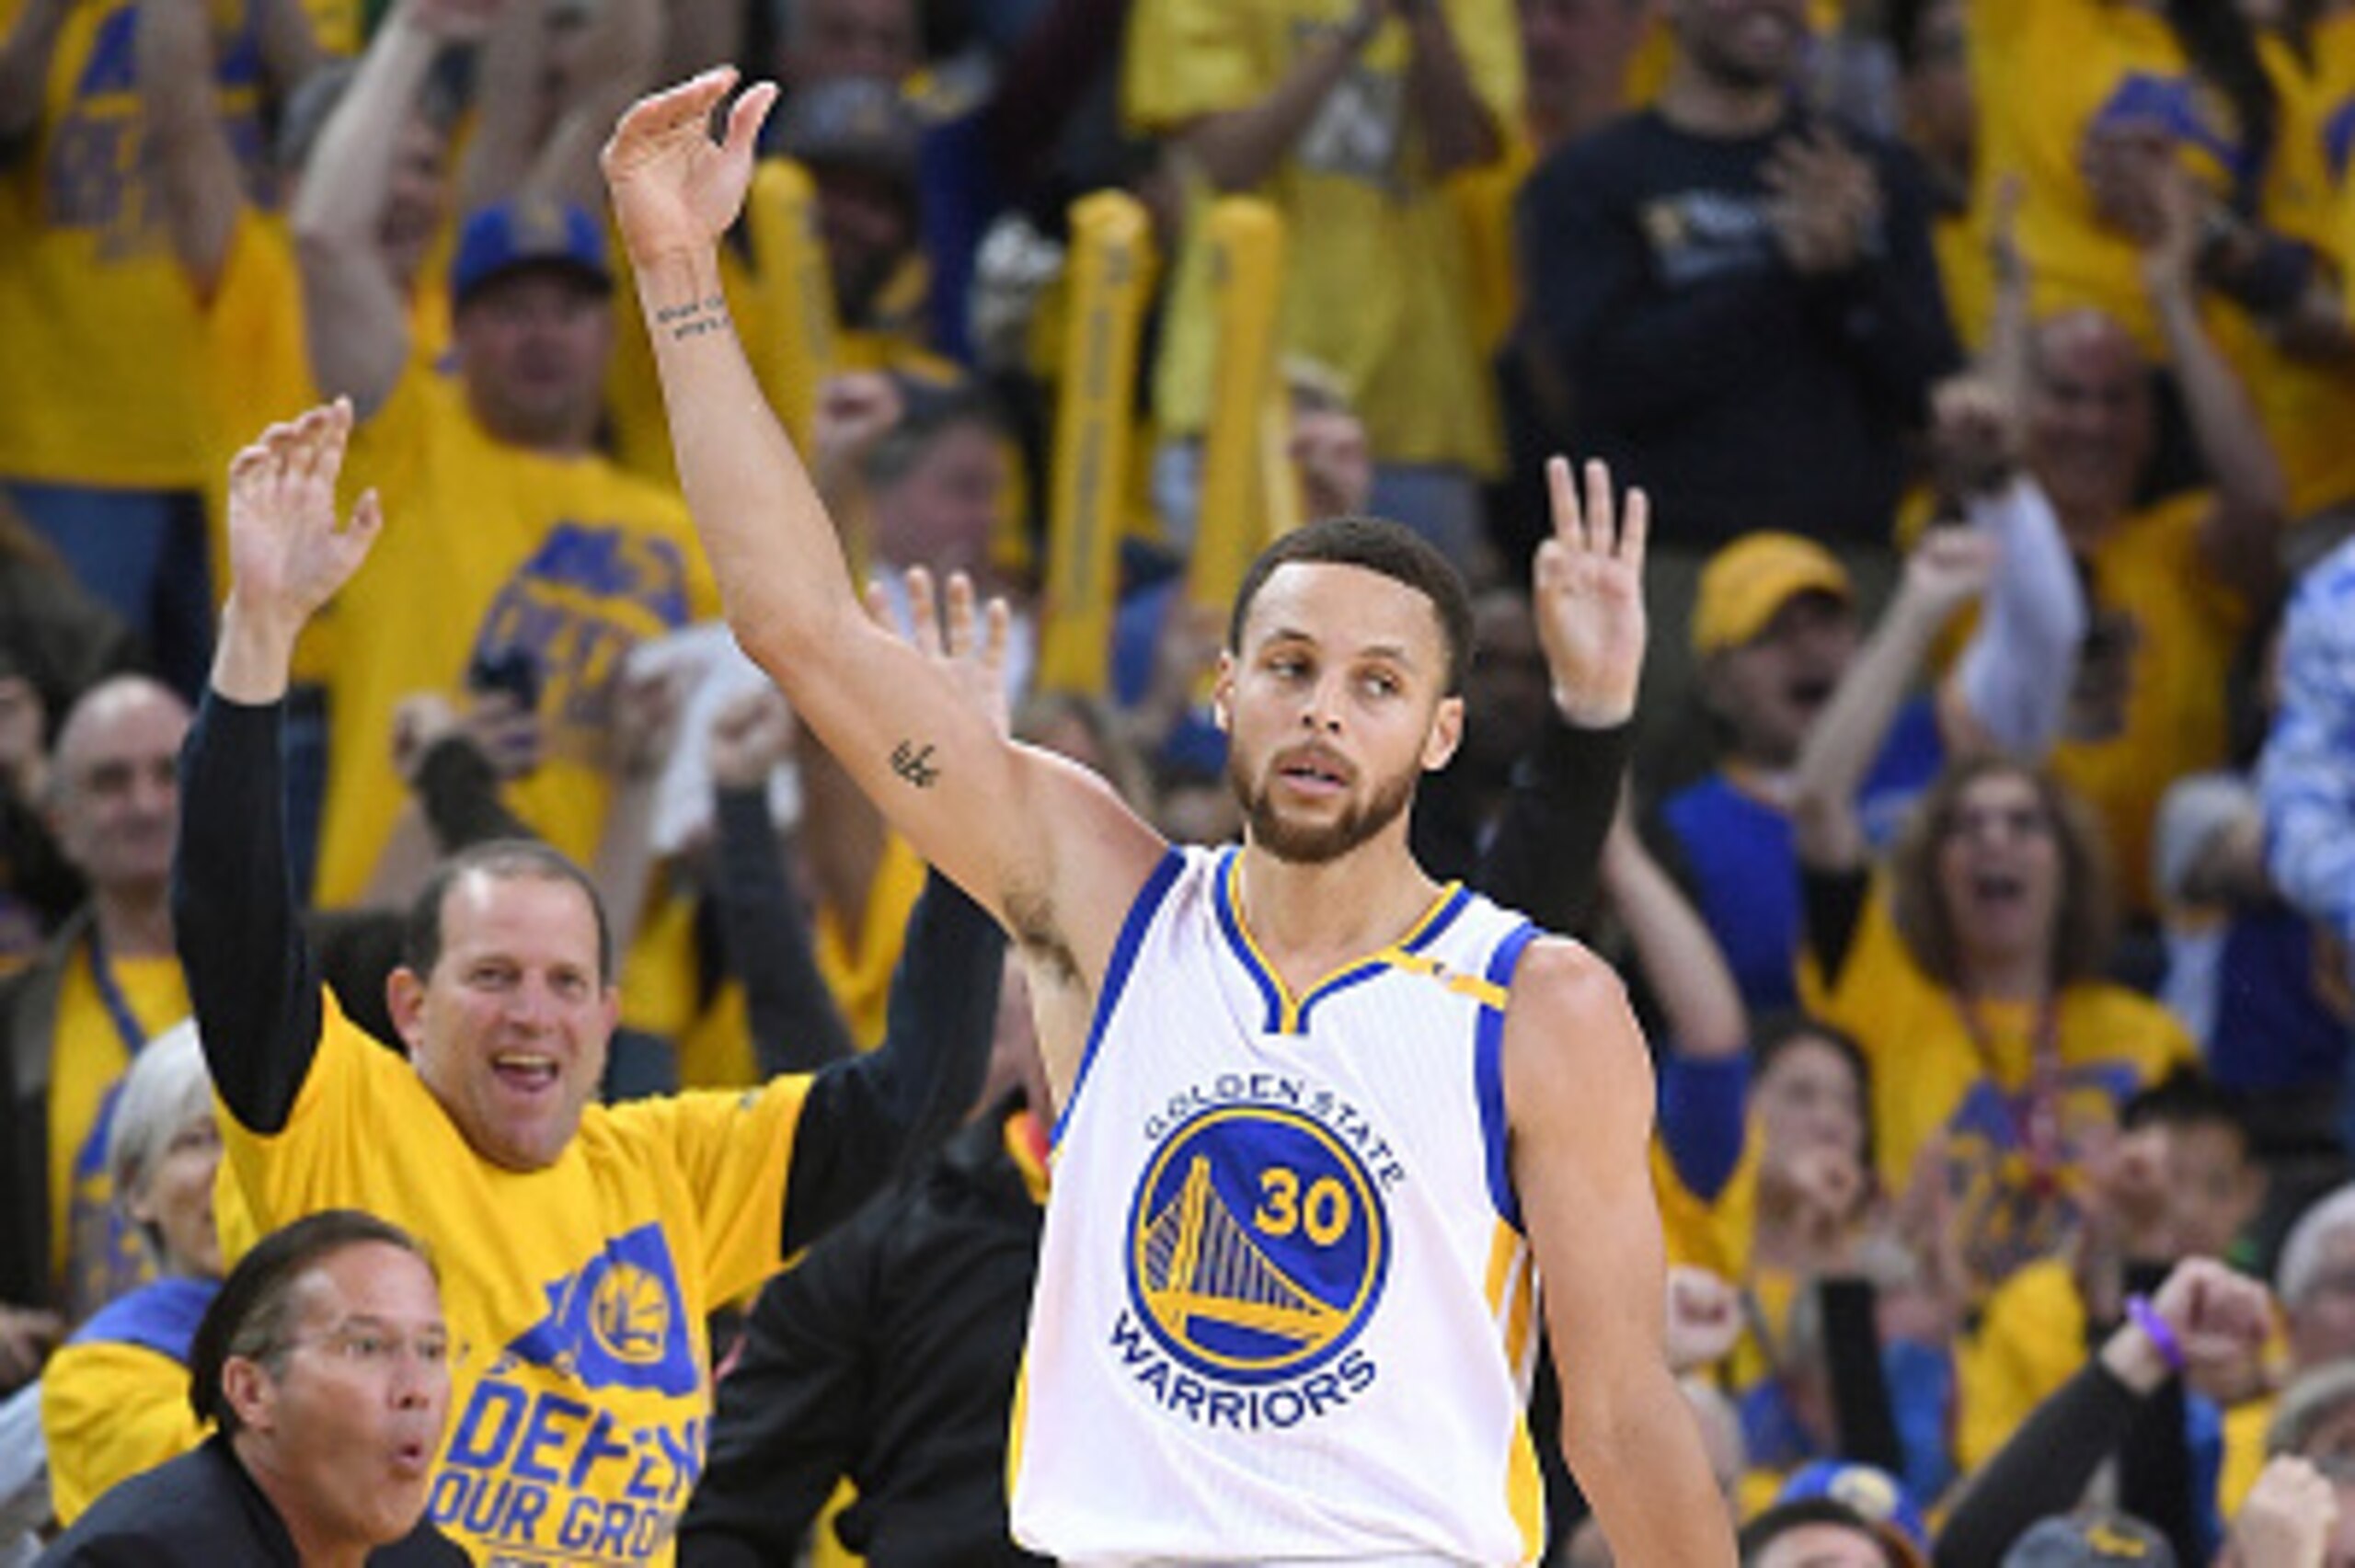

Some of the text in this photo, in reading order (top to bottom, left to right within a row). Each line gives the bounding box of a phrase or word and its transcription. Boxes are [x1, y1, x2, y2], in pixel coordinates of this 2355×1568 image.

[1143, 1072, 1406, 1194] GOLDEN STATE
[1255, 1166, 1350, 1246] 30
[1110, 1308, 1377, 1430] WARRIORS
[429, 1469, 548, 1541] OUR
